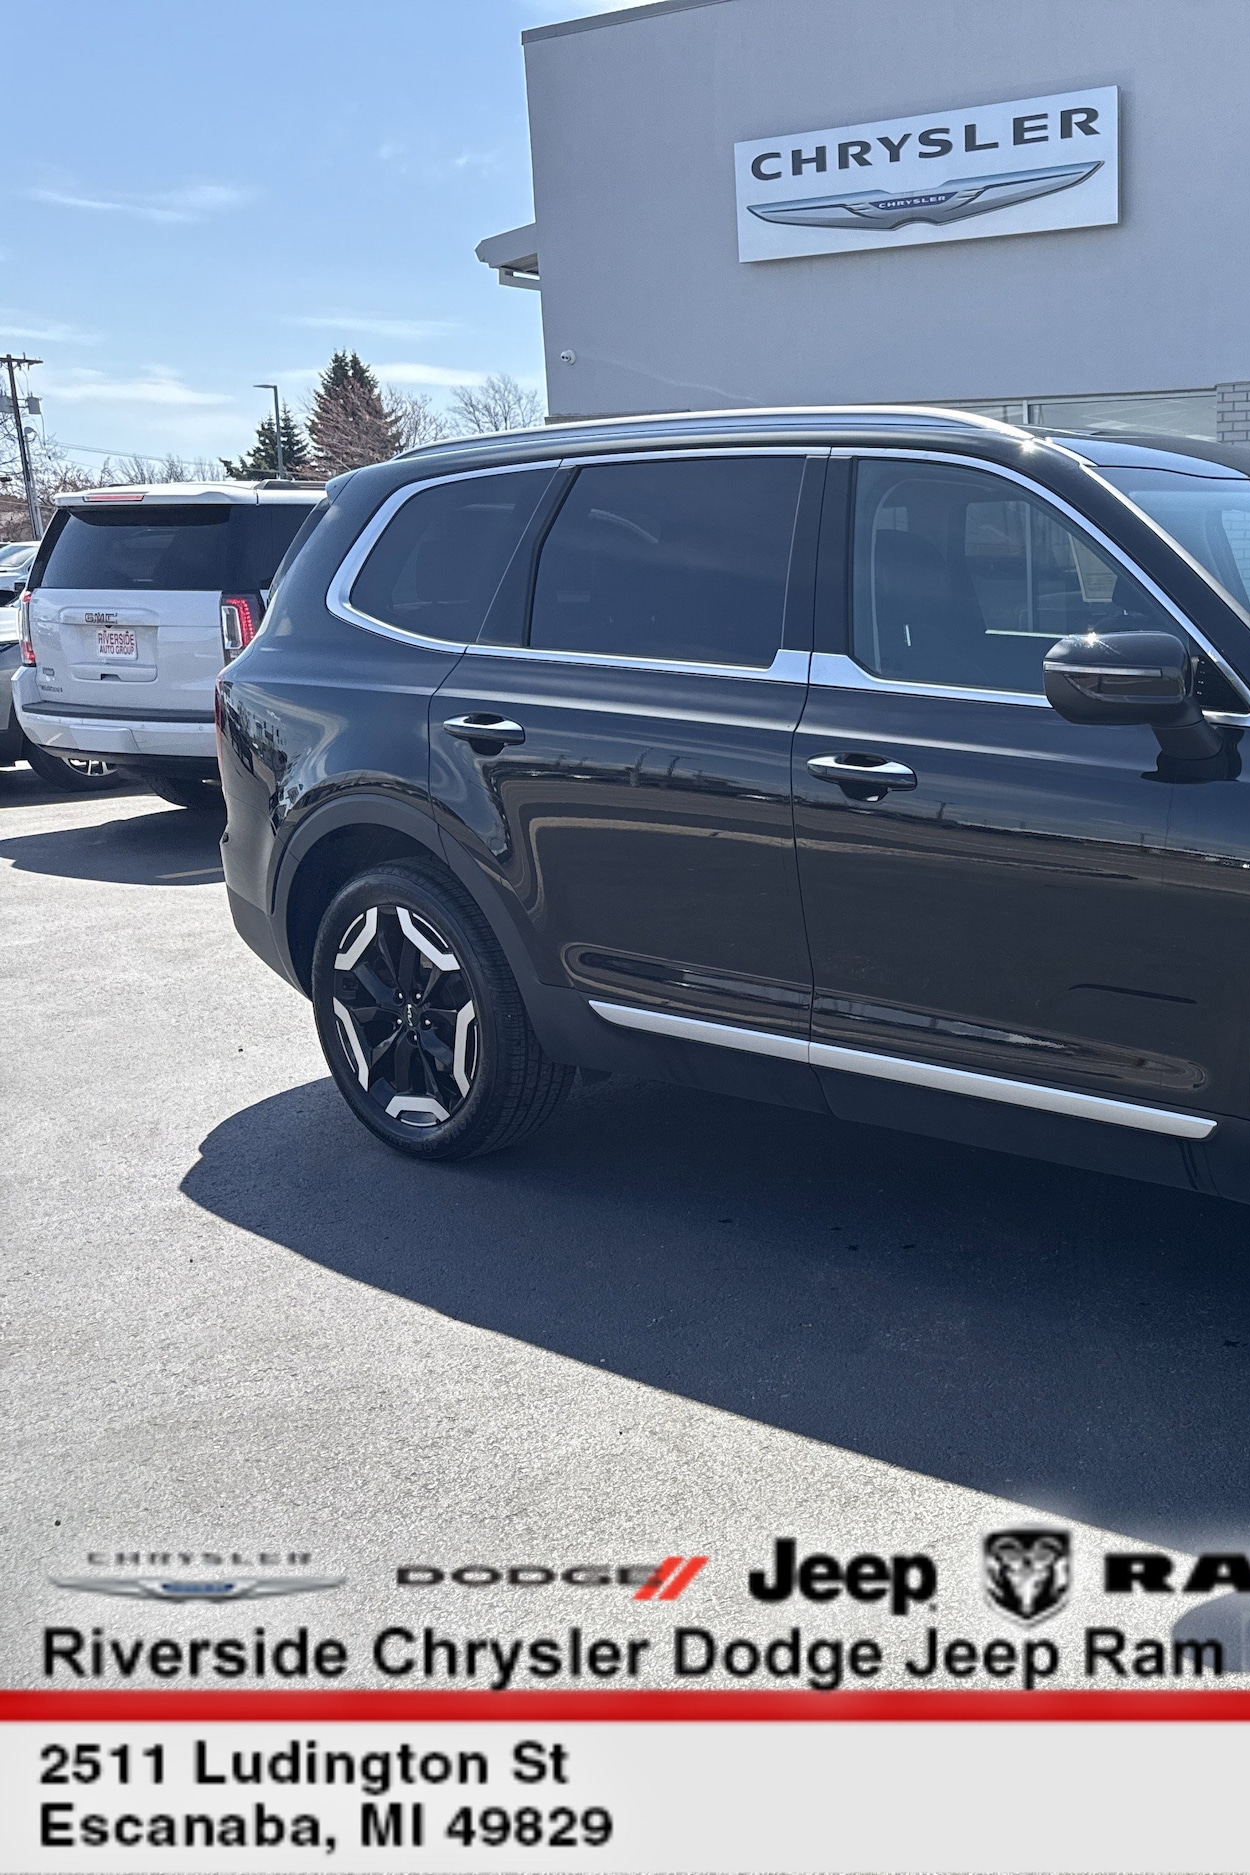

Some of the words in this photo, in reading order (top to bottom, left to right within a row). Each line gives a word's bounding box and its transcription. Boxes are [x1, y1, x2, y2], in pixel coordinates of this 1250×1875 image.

[751, 107, 1101, 181] CHRYSLER
[878, 196, 946, 209] CHRYSLER
[84, 612, 118, 624] GMC
[98, 632, 135, 646] RIVERSIDE
[99, 645, 115, 654] AUTO
[116, 645, 135, 655] GROUP
